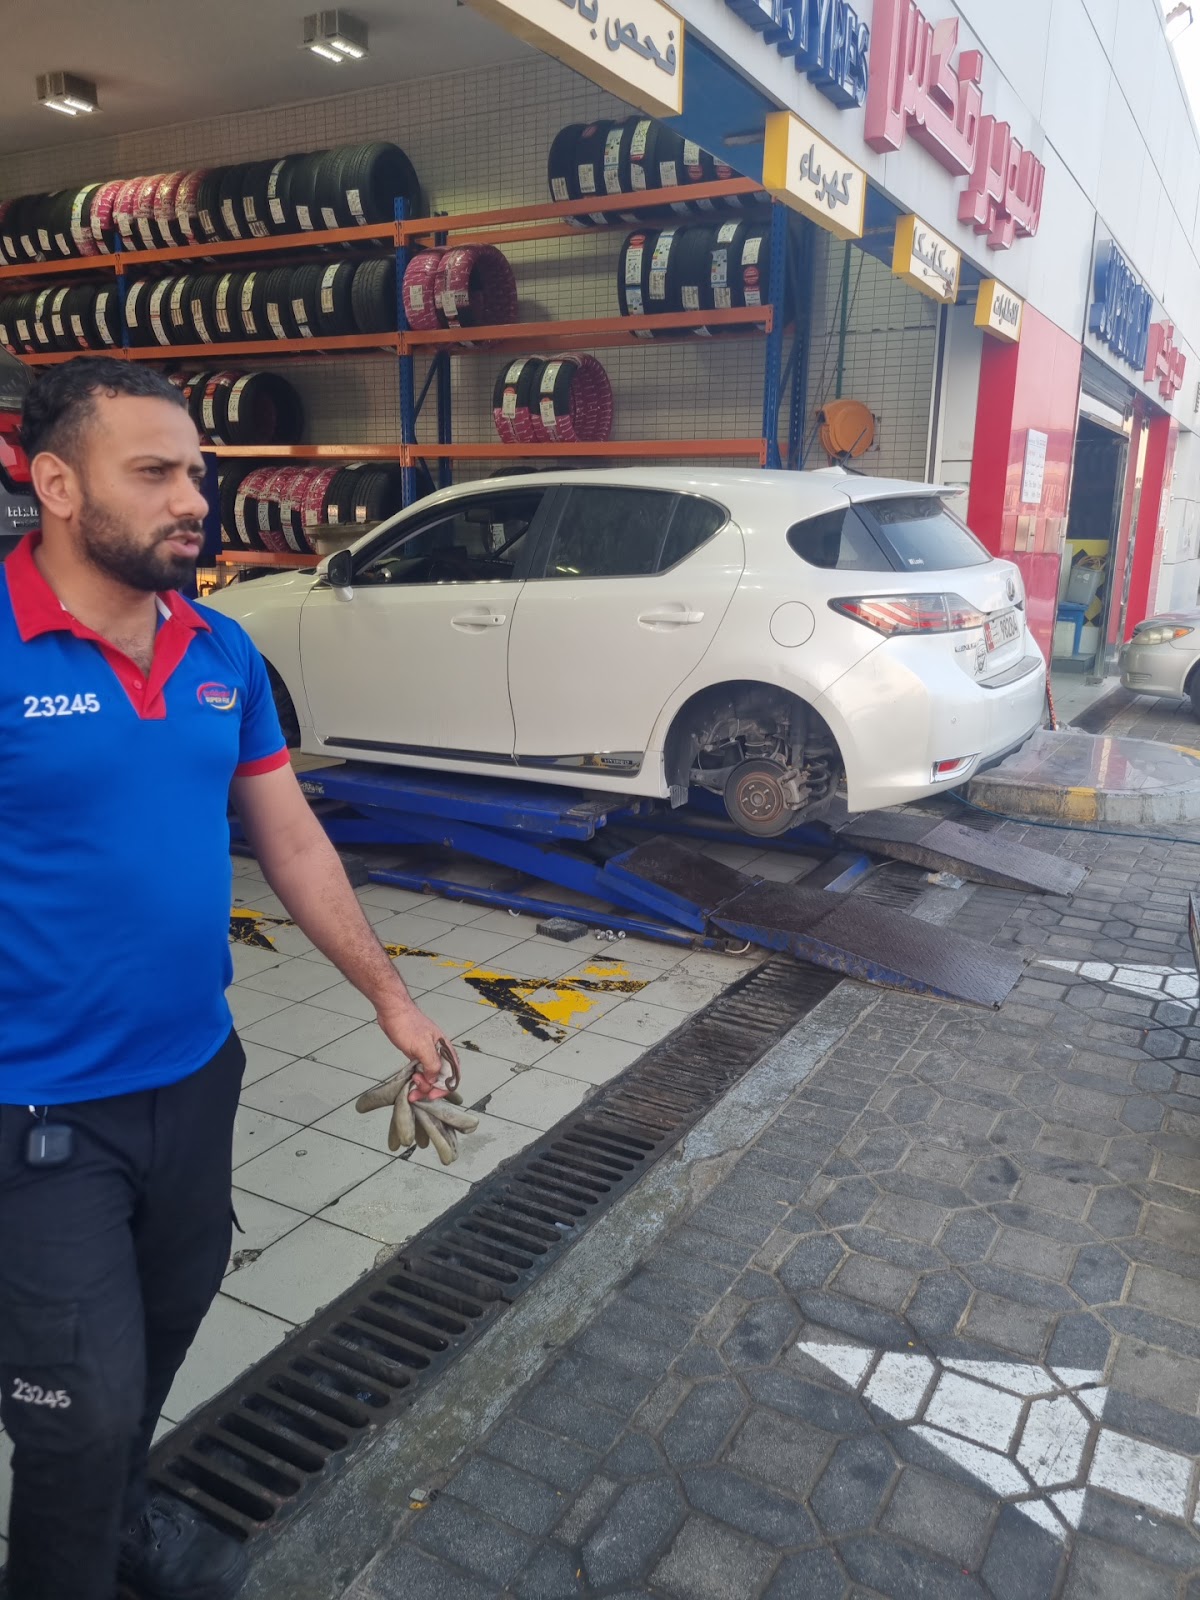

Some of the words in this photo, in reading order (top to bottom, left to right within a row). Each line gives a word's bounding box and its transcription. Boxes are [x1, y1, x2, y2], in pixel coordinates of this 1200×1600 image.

[605, 18, 677, 76] فحص
[800, 144, 853, 209] كهرباء
[24, 693, 100, 718] 23245
[11, 1377, 72, 1408] 23245
